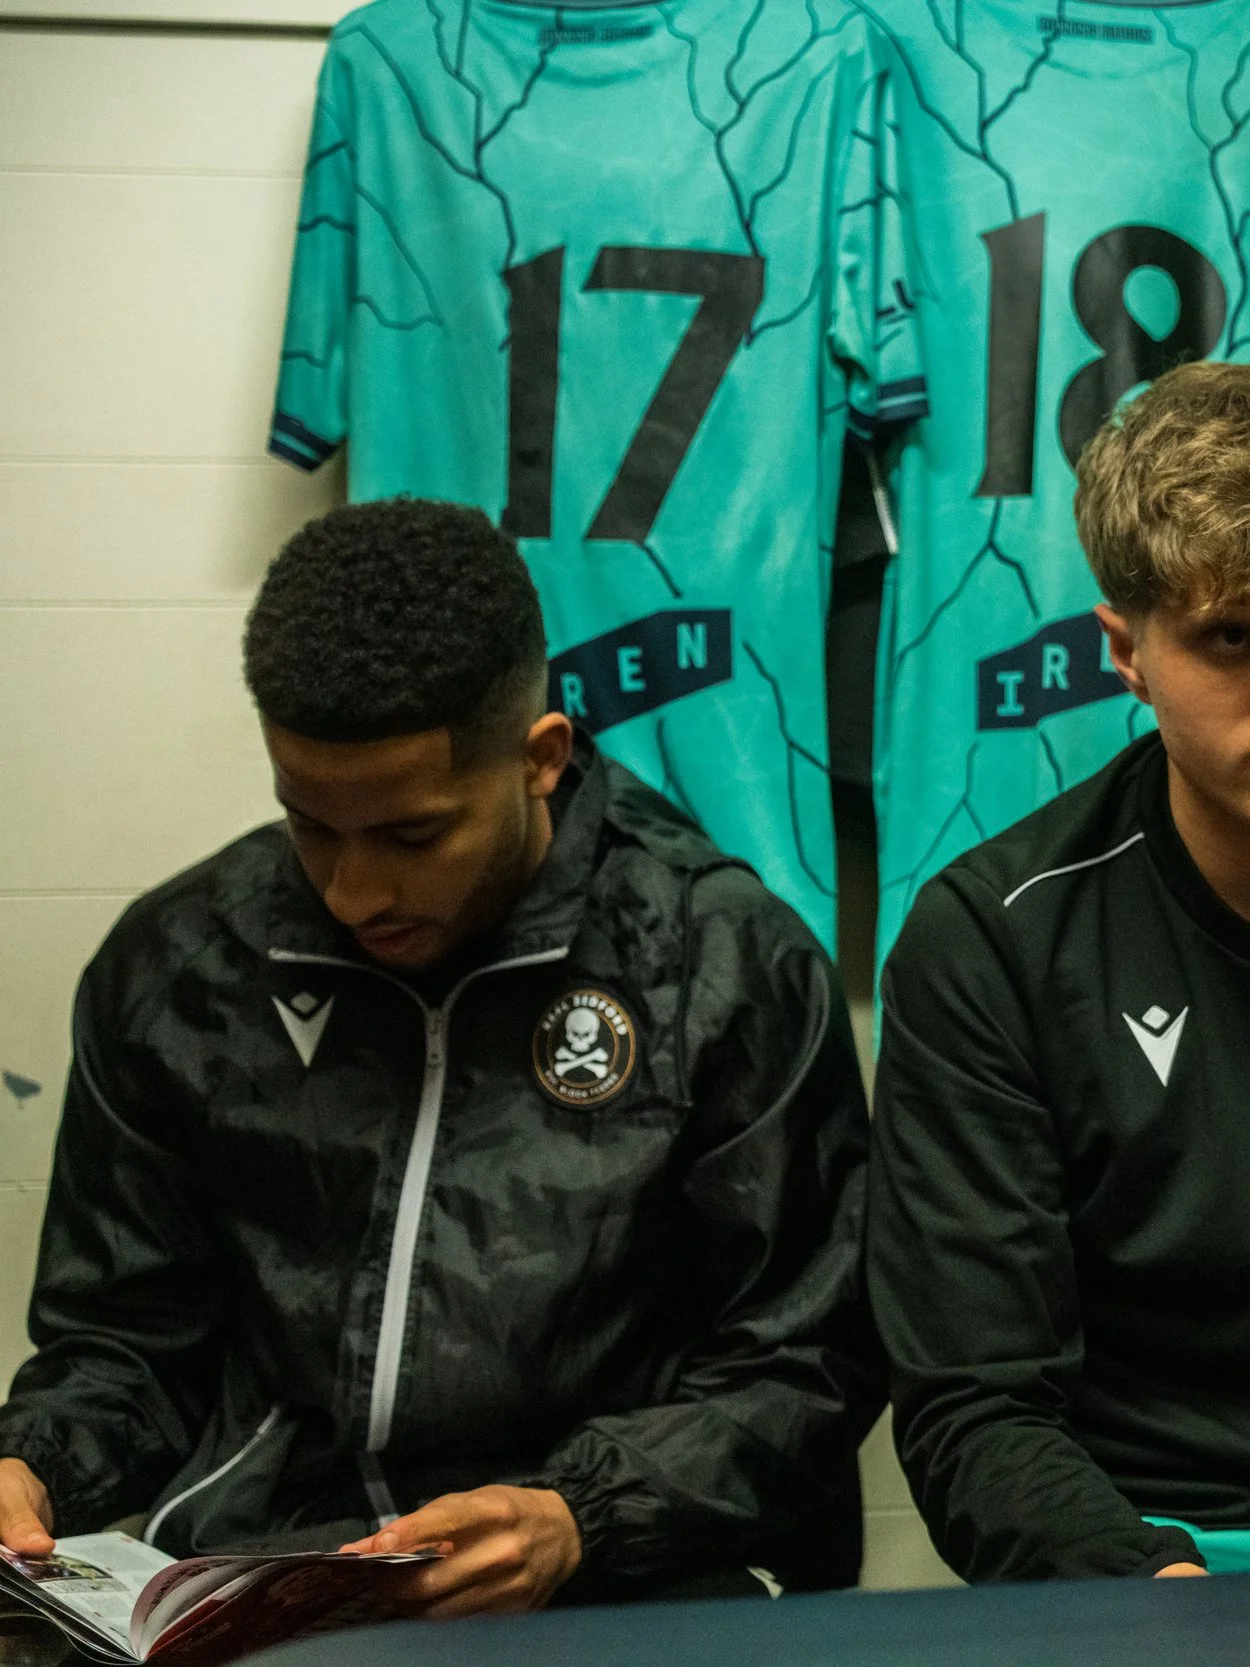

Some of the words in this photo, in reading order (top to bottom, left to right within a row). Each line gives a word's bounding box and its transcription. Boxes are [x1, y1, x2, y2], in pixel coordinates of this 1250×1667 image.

[500, 246, 766, 542] 17
[973, 212, 1229, 498] 18
[560, 622, 708, 717] REN
[996, 631, 1117, 716] IR
